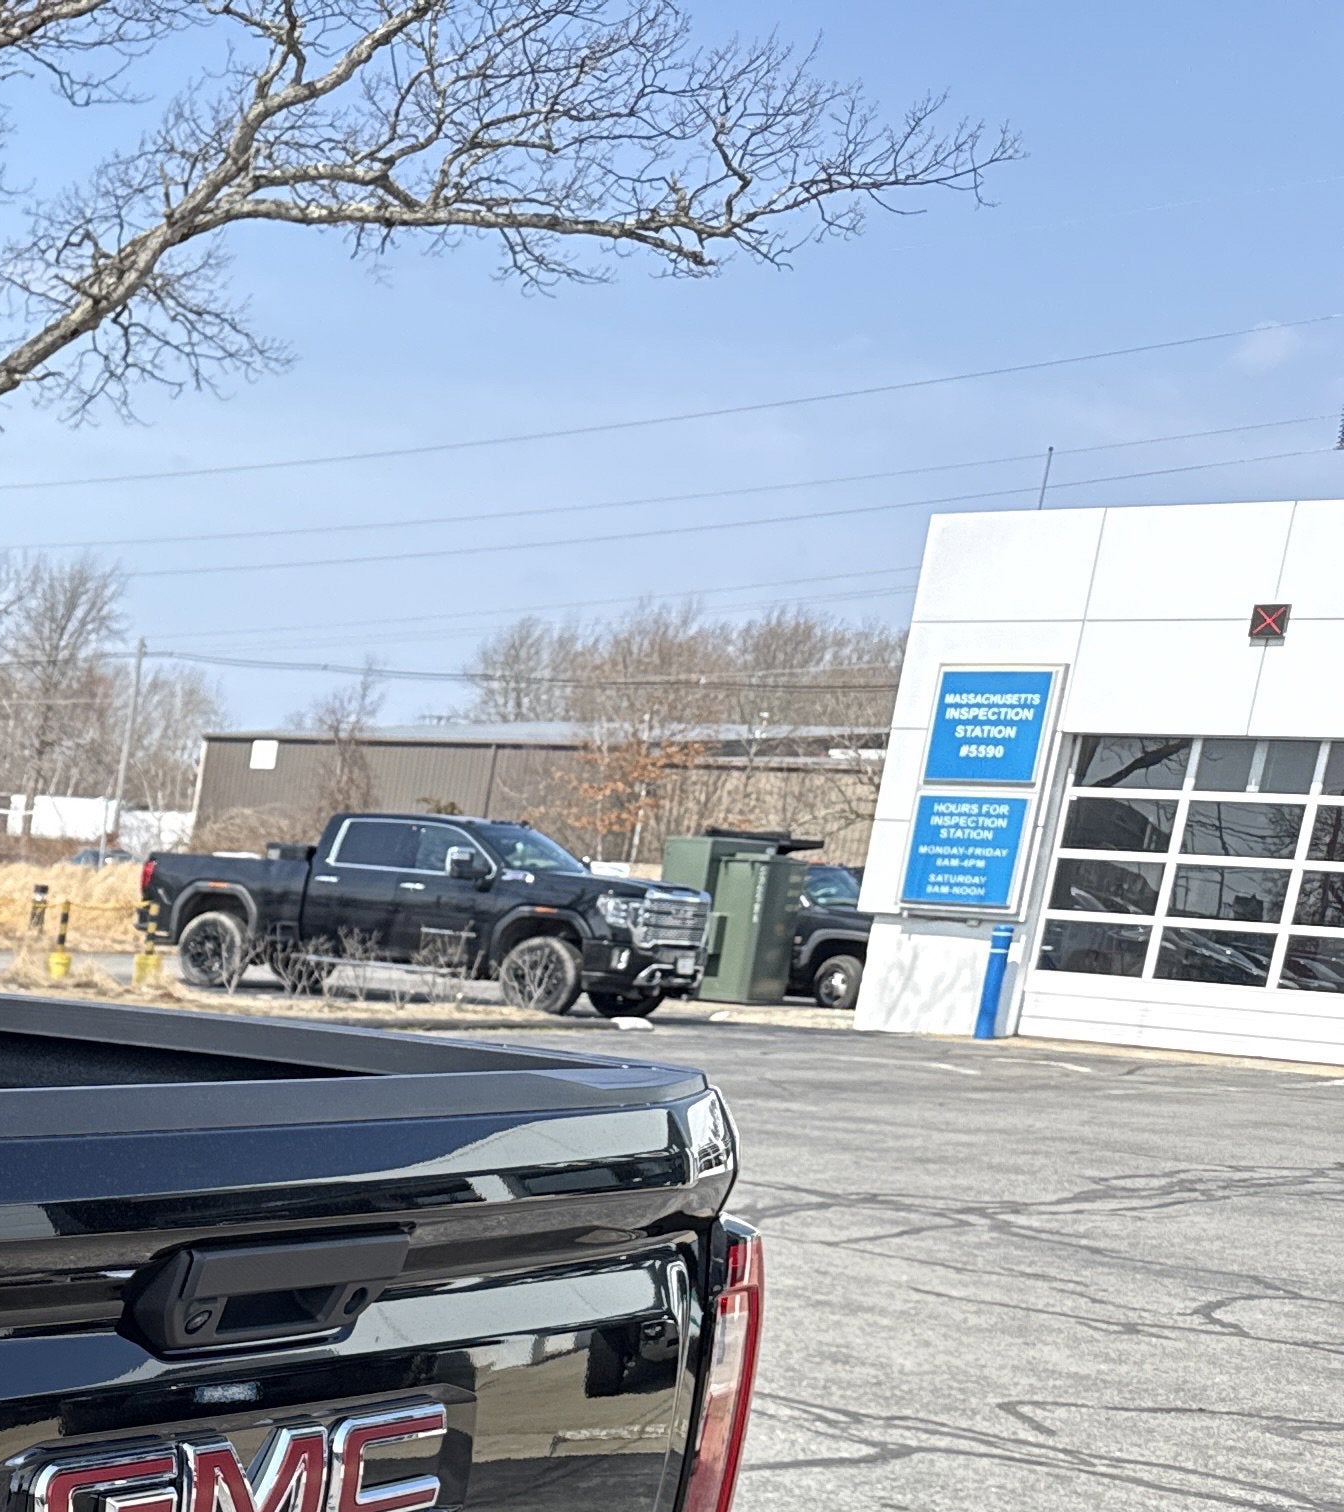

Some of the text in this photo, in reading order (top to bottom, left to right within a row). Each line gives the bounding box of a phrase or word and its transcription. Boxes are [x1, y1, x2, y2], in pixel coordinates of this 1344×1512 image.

[944, 693, 1041, 705] MASSACHUSETTS
[945, 707, 1035, 721] INSPECTION
[954, 725, 1017, 739] STATION
[959, 744, 1005, 758] #5590
[933, 802, 1010, 815] HOURS FOR
[930, 815, 1008, 829] INSPECTION
[939, 828, 994, 840] STATION
[918, 845, 1009, 857] MONDAY-FRIDAY
[928, 873, 987, 884] SATURDAY
